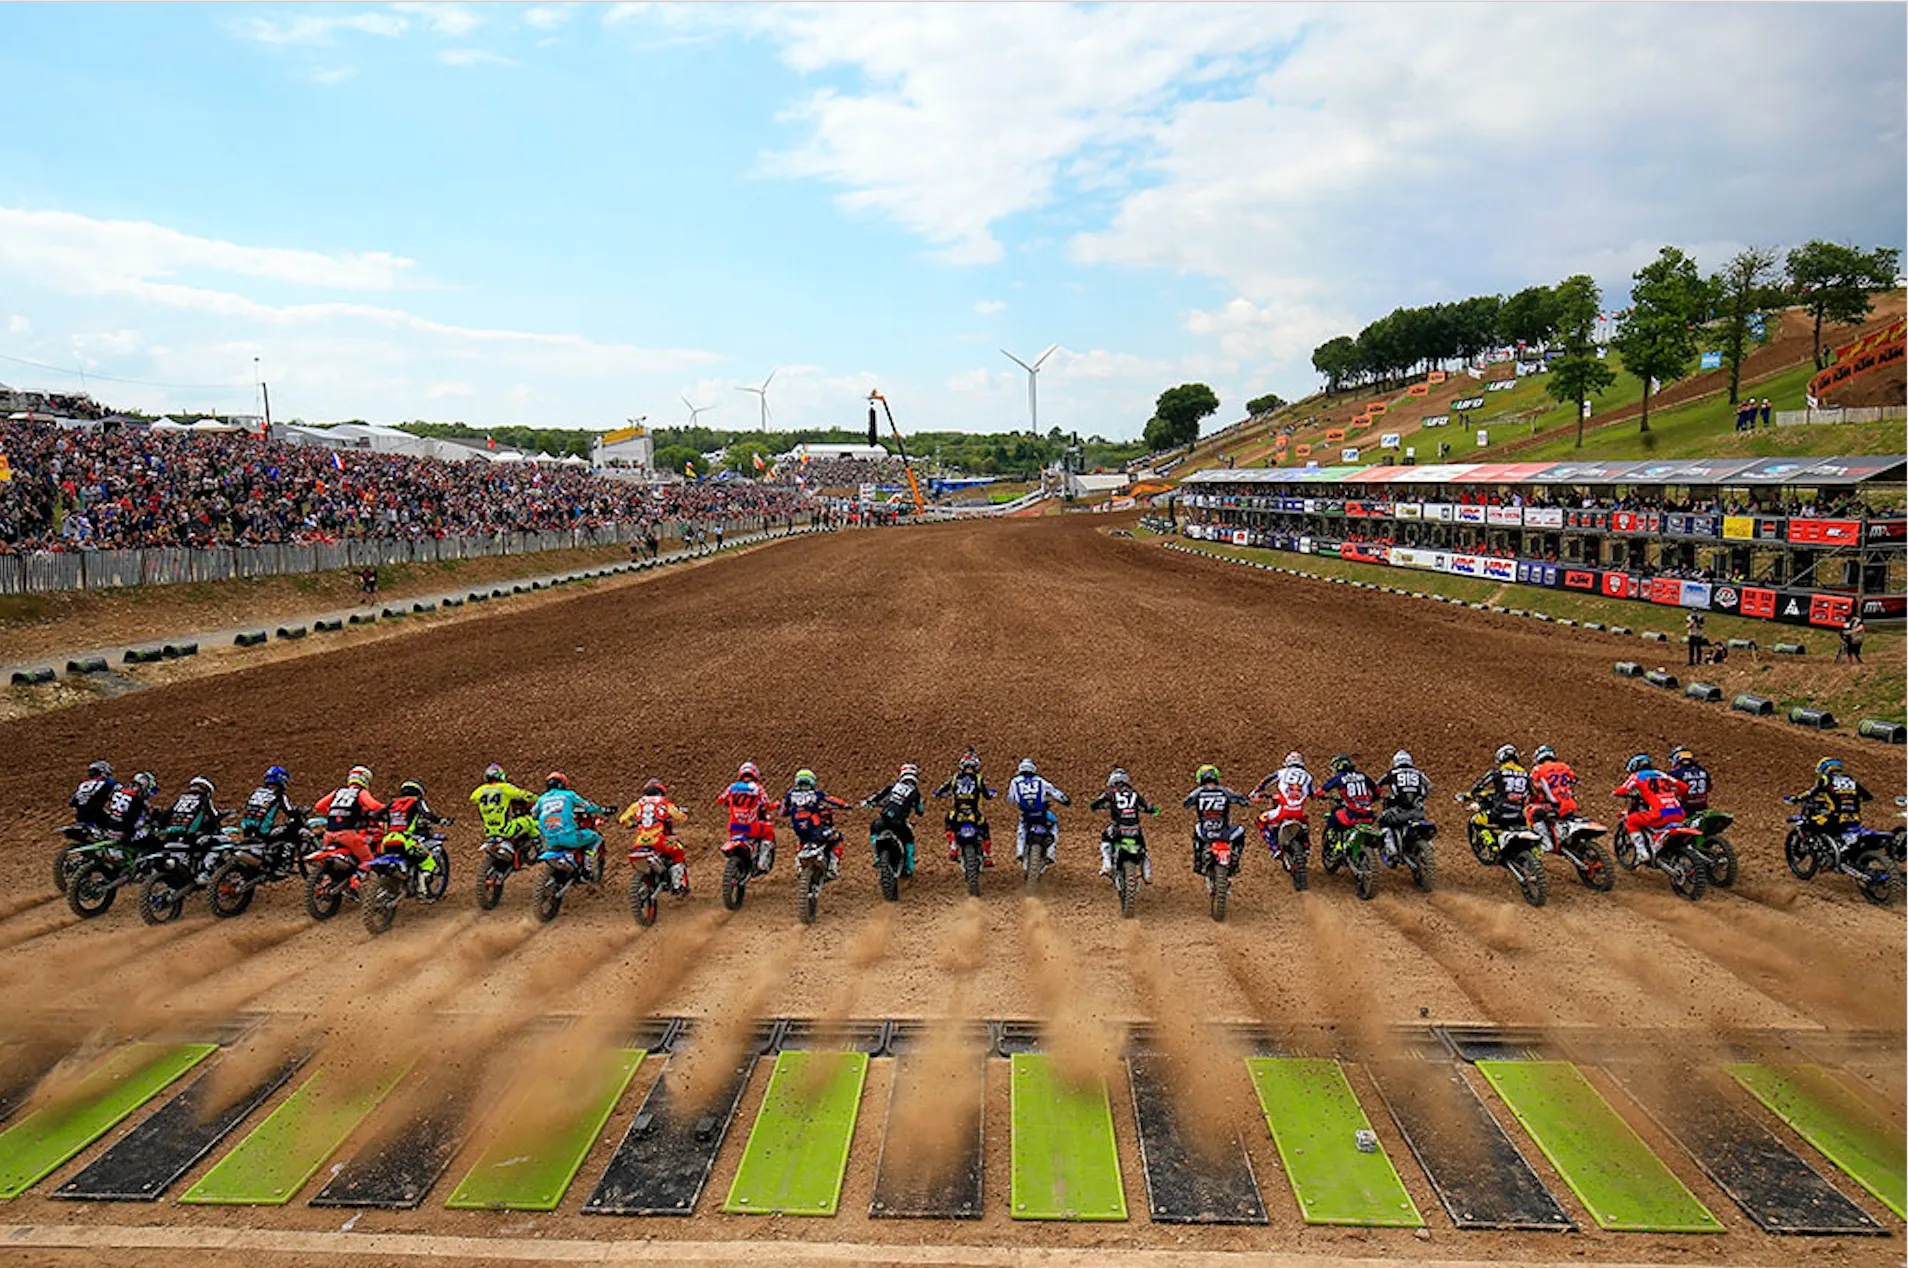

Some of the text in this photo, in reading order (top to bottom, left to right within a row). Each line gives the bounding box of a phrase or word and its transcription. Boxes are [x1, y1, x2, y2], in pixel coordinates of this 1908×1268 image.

[1456, 398, 1484, 410] UFO
[1286, 771, 1307, 785] 61
[1396, 772, 1419, 787] 919
[480, 793, 501, 806] 44
[1115, 792, 1137, 809] 57
[1199, 797, 1226, 811] 172
